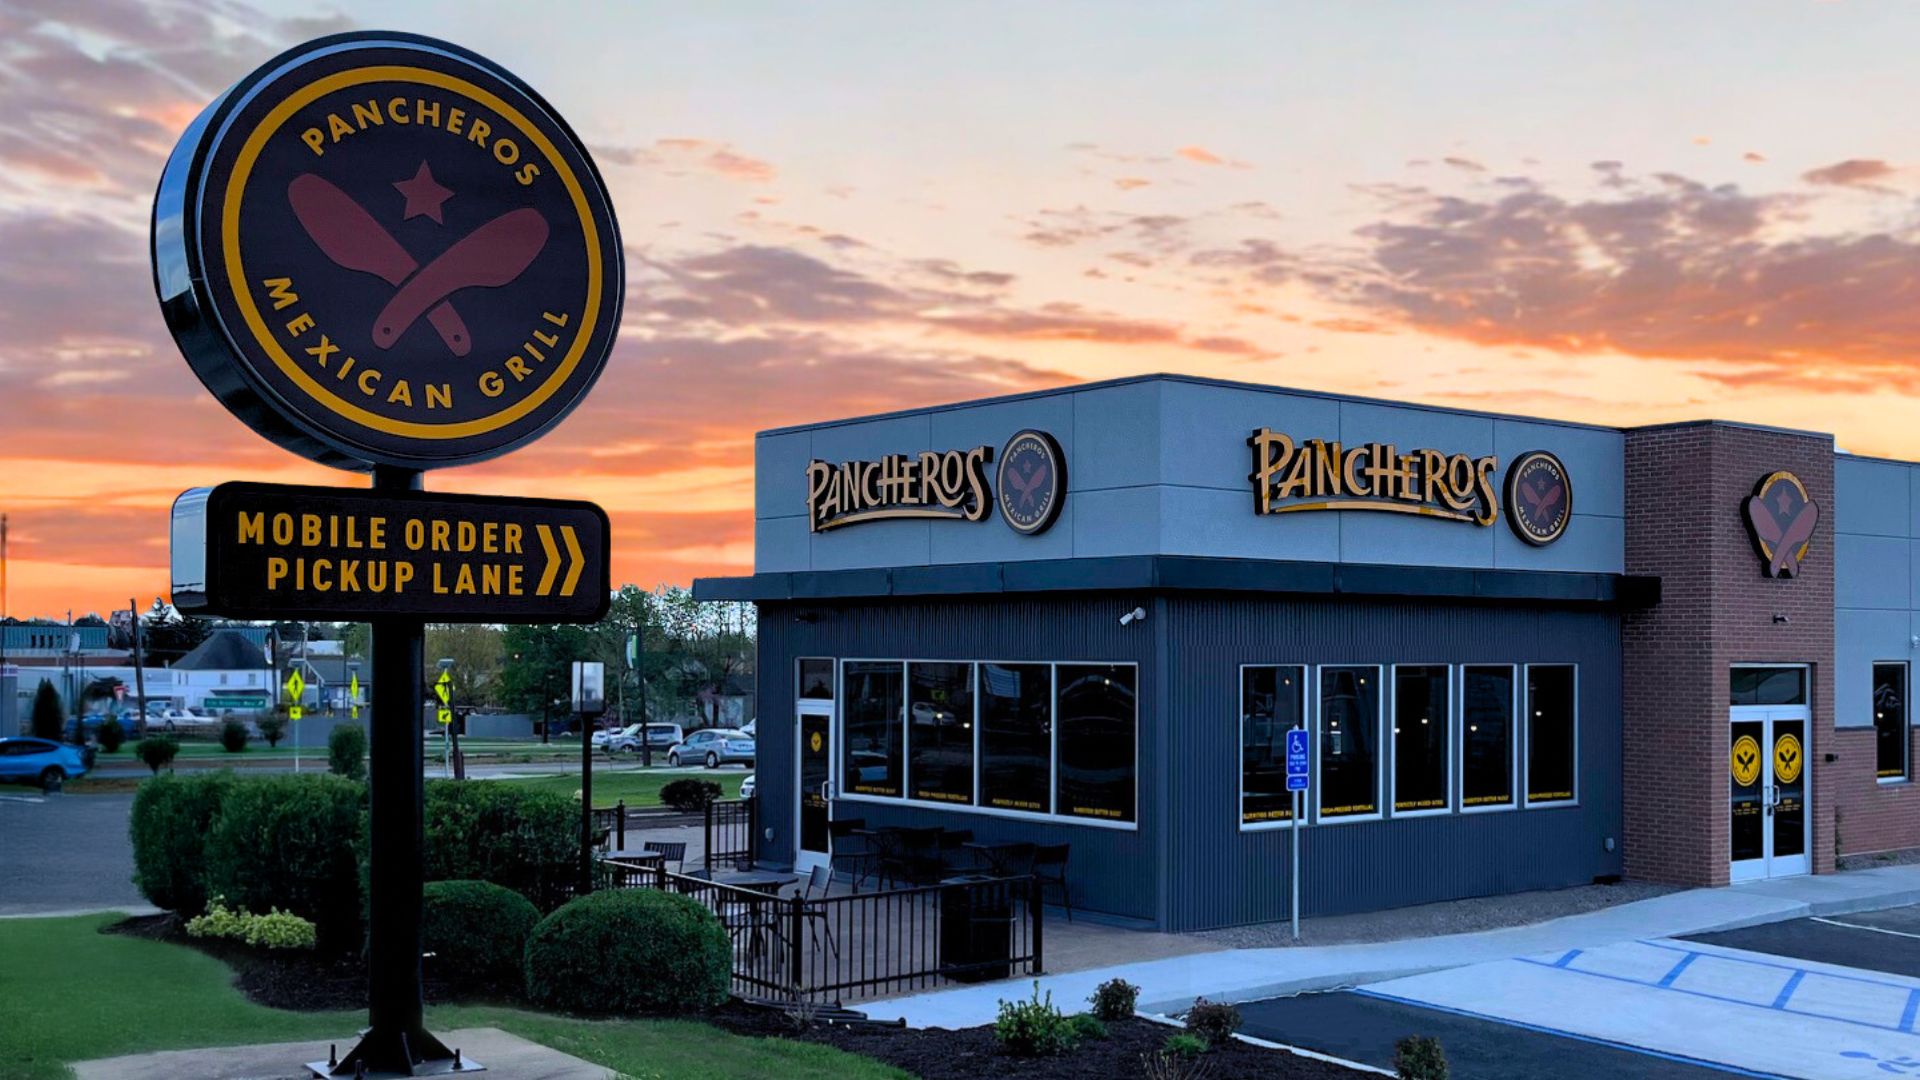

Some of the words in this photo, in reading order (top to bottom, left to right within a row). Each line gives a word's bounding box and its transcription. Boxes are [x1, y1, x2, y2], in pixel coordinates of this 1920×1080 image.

[300, 97, 541, 187] PANCHEROS
[263, 276, 453, 409] MEXICAN
[478, 306, 570, 398] GRILL
[1009, 442, 1046, 463] PANCHEROS
[1523, 462, 1560, 481] PANCHEROS
[806, 446, 988, 533] PANCHEROS
[1253, 427, 1498, 527] PANCHEROS
[1004, 493, 1032, 522] MEXICAN
[1519, 506, 1548, 535] MEXICAN
[237, 510, 387, 549] MOBILE
[405, 518, 524, 554] ORDER
[267, 556, 415, 593] PICKUP
[432, 562, 524, 596] LANE
